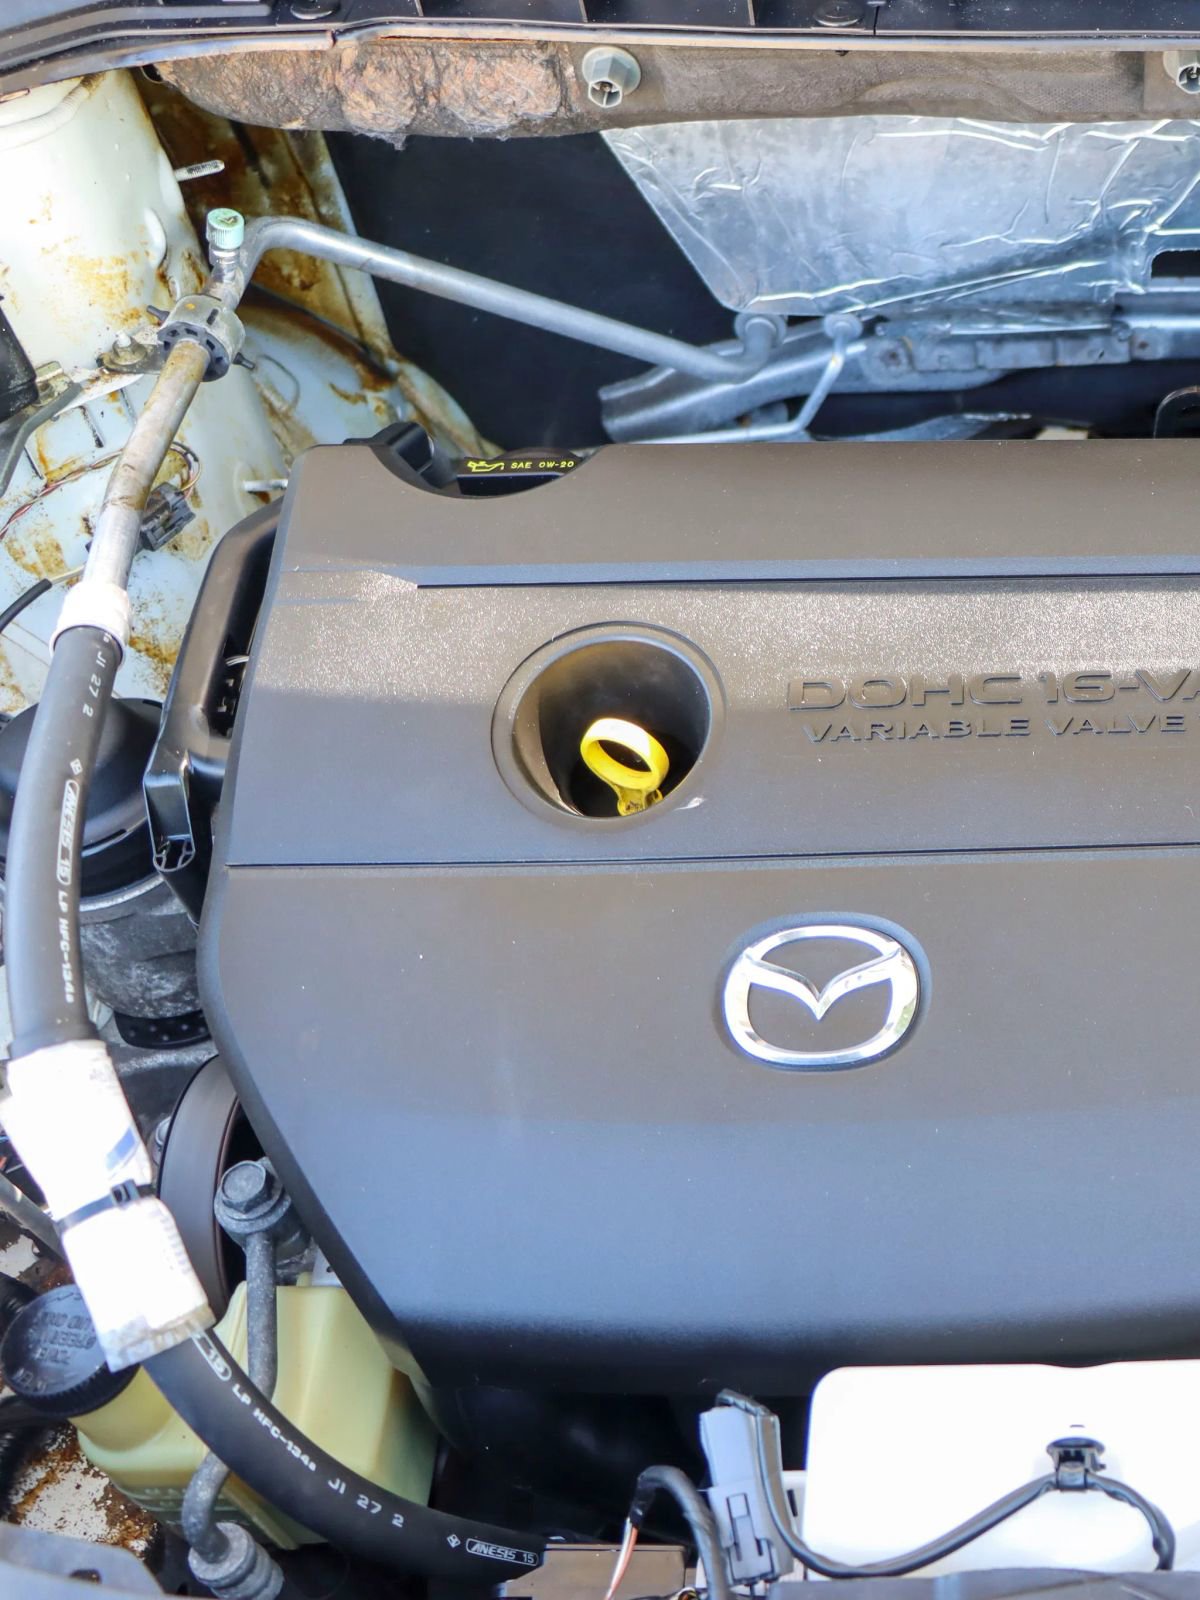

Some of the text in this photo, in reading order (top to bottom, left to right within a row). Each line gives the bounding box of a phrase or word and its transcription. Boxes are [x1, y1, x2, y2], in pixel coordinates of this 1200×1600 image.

[538, 460, 575, 468] 0W-20
[89, 673, 101, 698] 27
[786, 671, 1023, 711] DOHC
[82, 703, 94, 717] 2
[801, 718, 1031, 744] VARIABLE
[1045, 713, 1186, 737] VALVE
[58, 890, 68, 913] LP
[58, 917, 74, 1004] HFC-134a
[232, 1383, 251, 1406] LP
[252, 1408, 317, 1472] HFC-134a
[356, 1494, 382, 1514] 27
[391, 1513, 405, 1528] 2
[522, 1552, 535, 1564] 15
